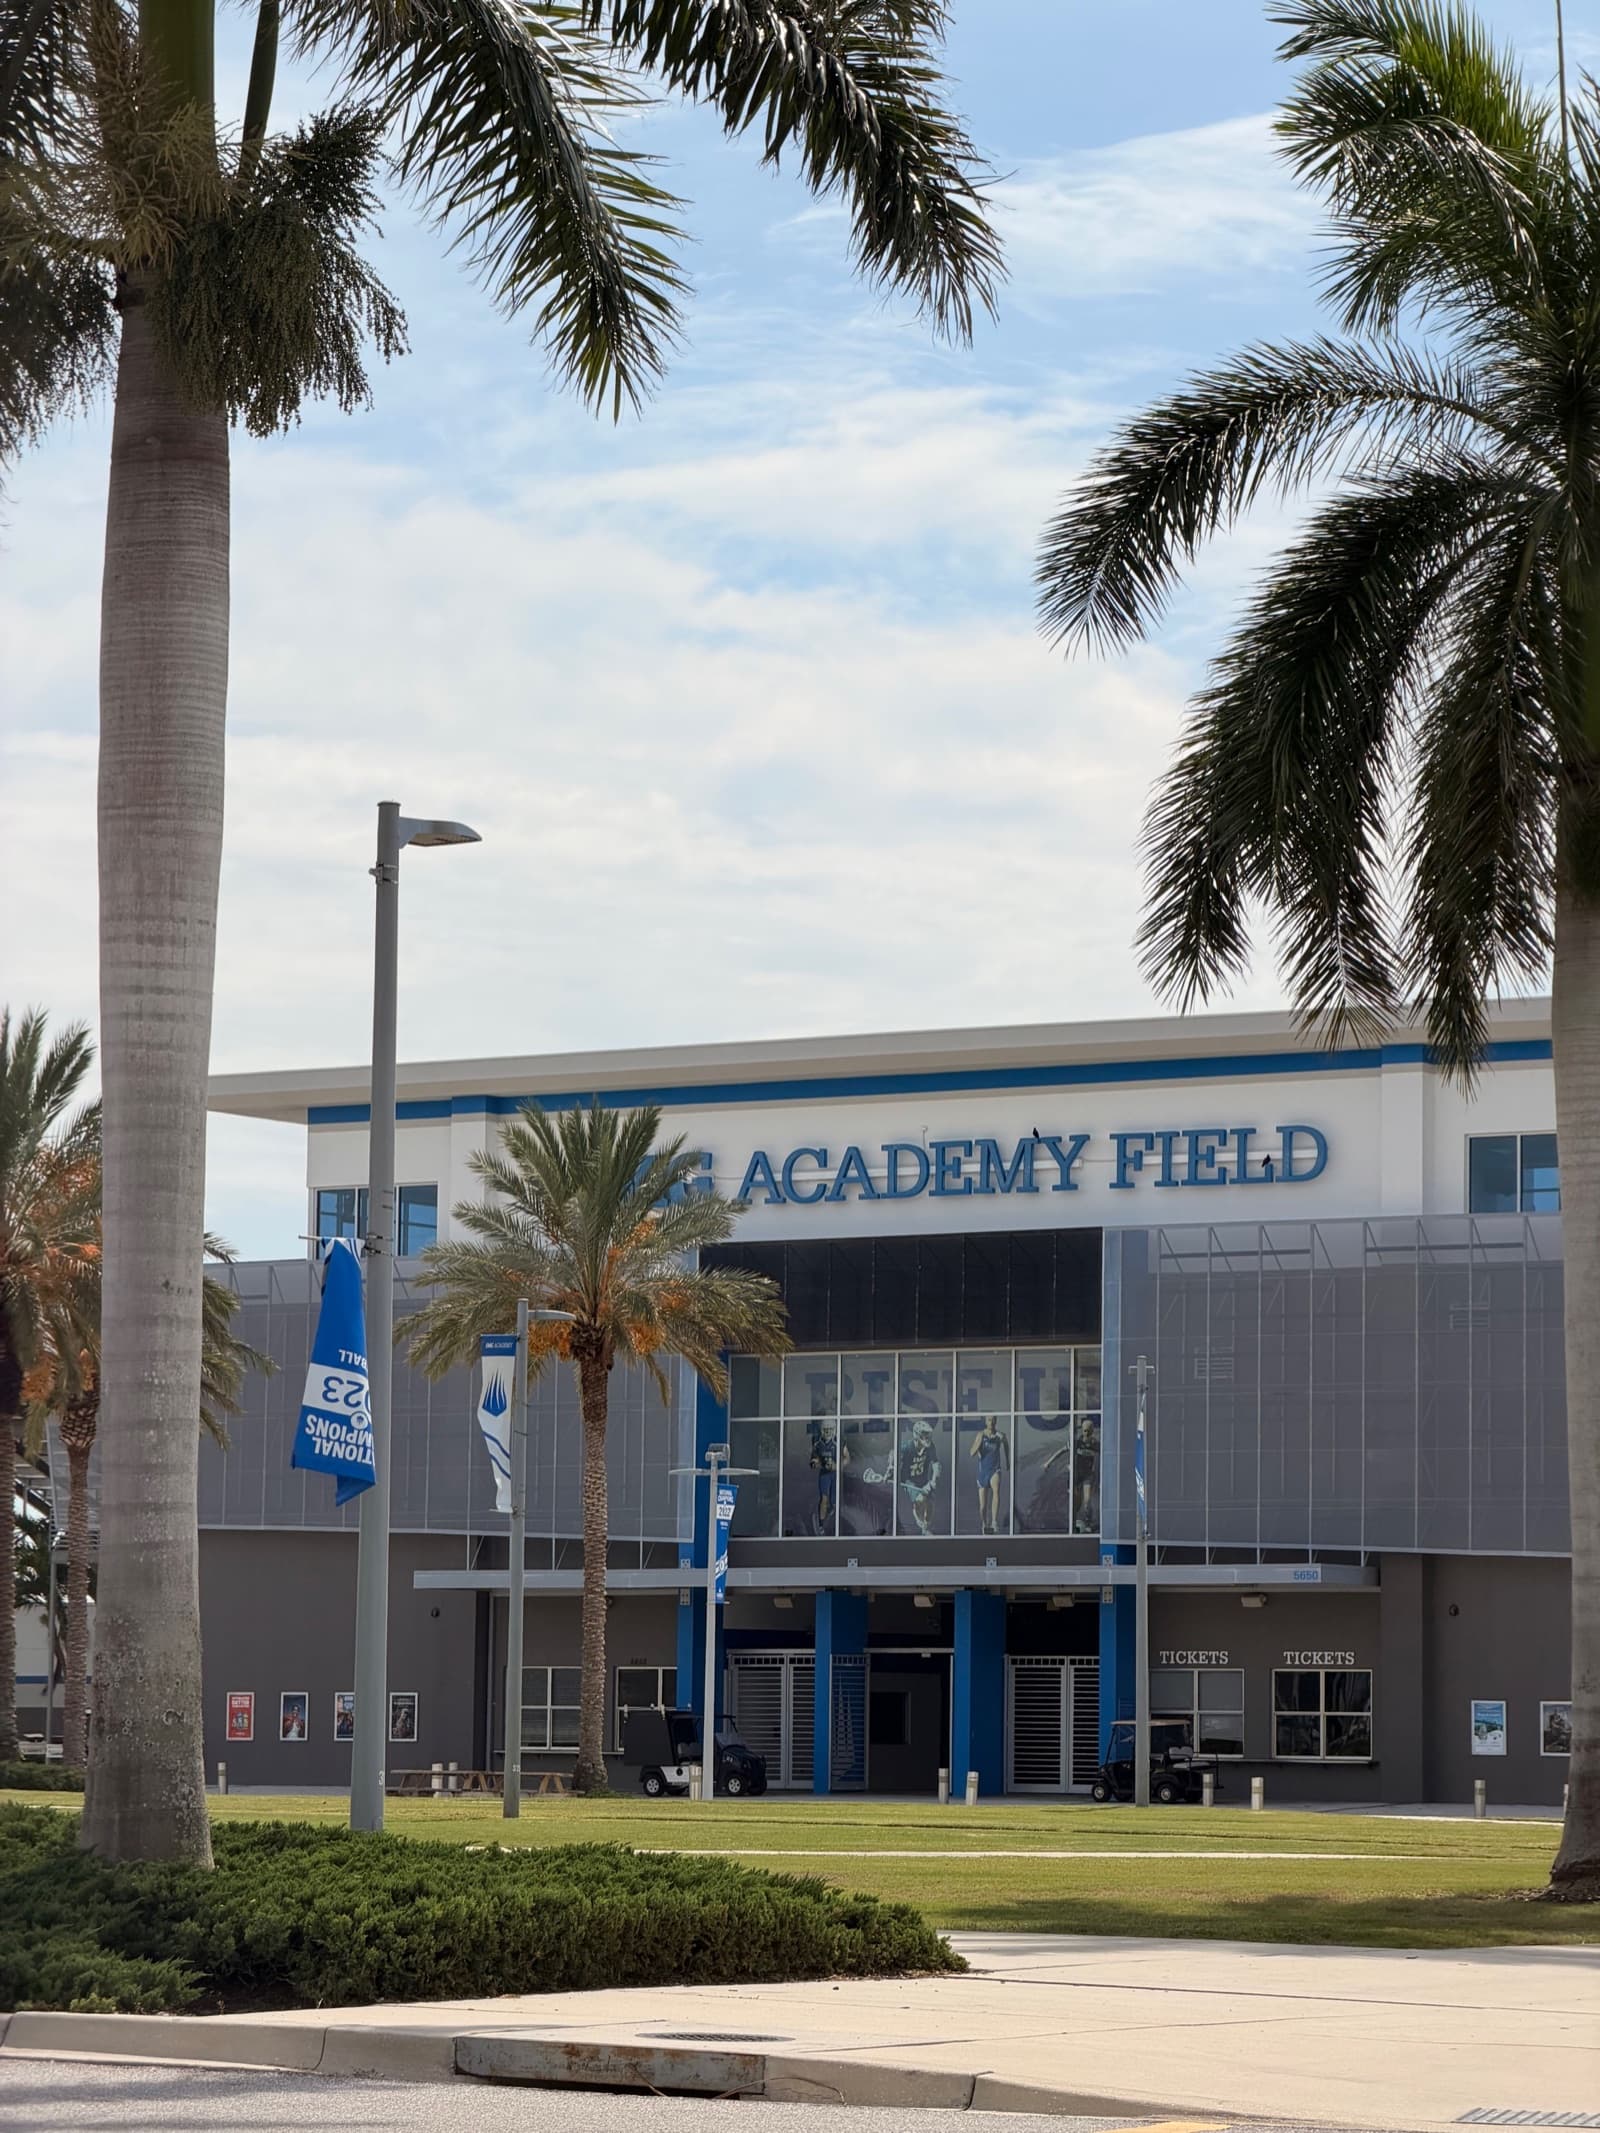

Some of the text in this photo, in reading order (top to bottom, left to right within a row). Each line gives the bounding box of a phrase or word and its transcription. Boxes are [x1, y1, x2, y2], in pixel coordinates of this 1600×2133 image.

[734, 1134, 1091, 1205] ACADEMY
[1109, 1124, 1329, 1189] FIELD
[321, 1375, 371, 1412] 23
[804, 1368, 993, 1435] RISE
[305, 1414, 373, 1447] MPIONS
[311, 1436, 374, 1465] TIONAL
[1294, 1570, 1319, 1581] 5650
[1159, 1650, 1229, 1665] TICKETS
[1283, 1651, 1355, 1666] TICKETS
